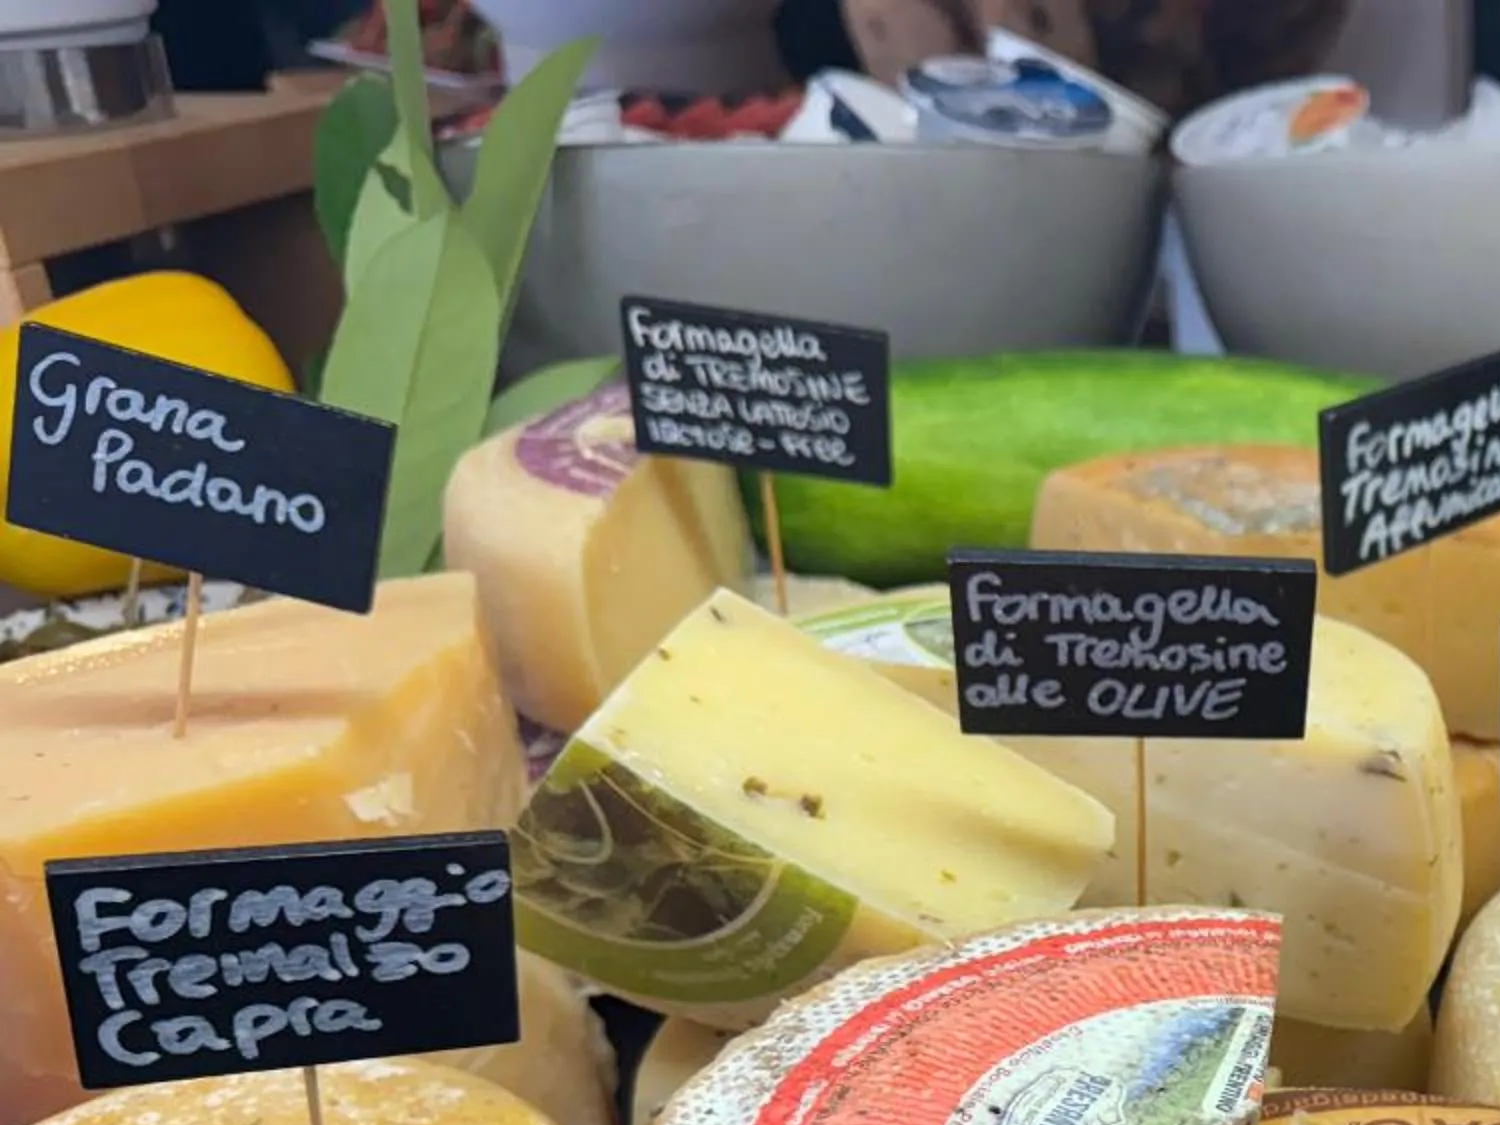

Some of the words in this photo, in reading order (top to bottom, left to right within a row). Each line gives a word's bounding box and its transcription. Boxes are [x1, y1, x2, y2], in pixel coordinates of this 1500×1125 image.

[642, 351, 681, 382] di
[29, 352, 245, 453] Grana
[641, 383, 734, 419] SENZA
[91, 428, 325, 534] Padano
[964, 630, 1024, 668] di
[1045, 632, 1287, 674] Tremosine
[963, 674, 1065, 709] alle
[1087, 677, 1248, 721] OLIVE
[73, 863, 512, 953] Formaggio
[97, 996, 383, 1067] Capra
